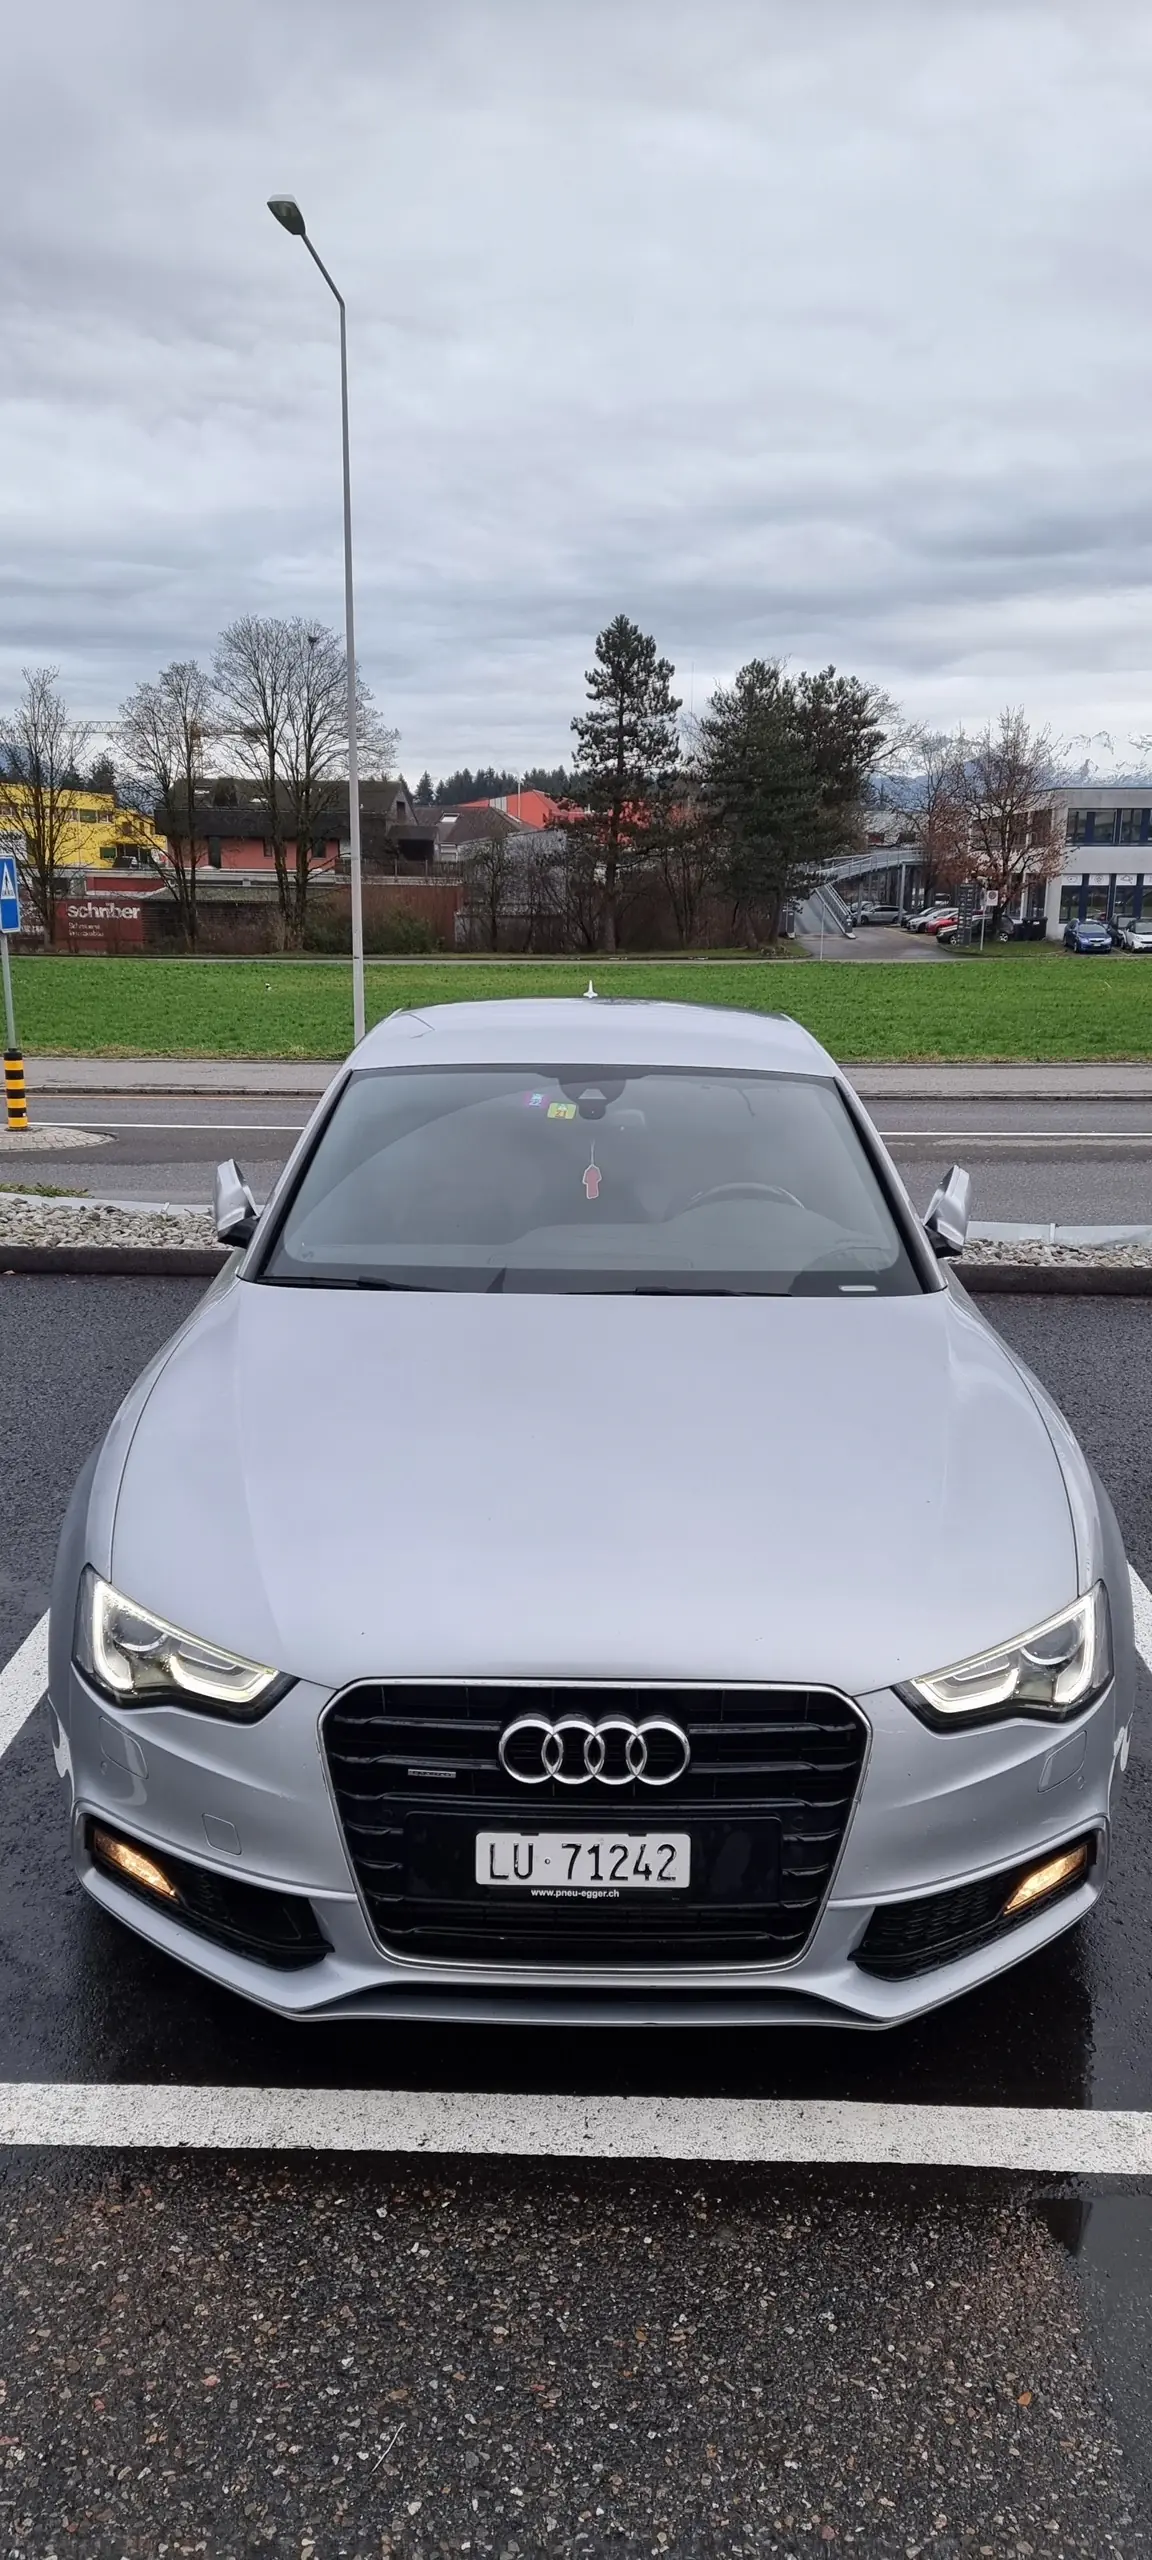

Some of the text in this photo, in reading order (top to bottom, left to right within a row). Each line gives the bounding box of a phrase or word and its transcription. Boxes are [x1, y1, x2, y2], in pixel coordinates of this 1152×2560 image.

[489, 1842, 677, 1881] LU 71242
[531, 1888, 620, 1898] www.pneu-egger.ch
